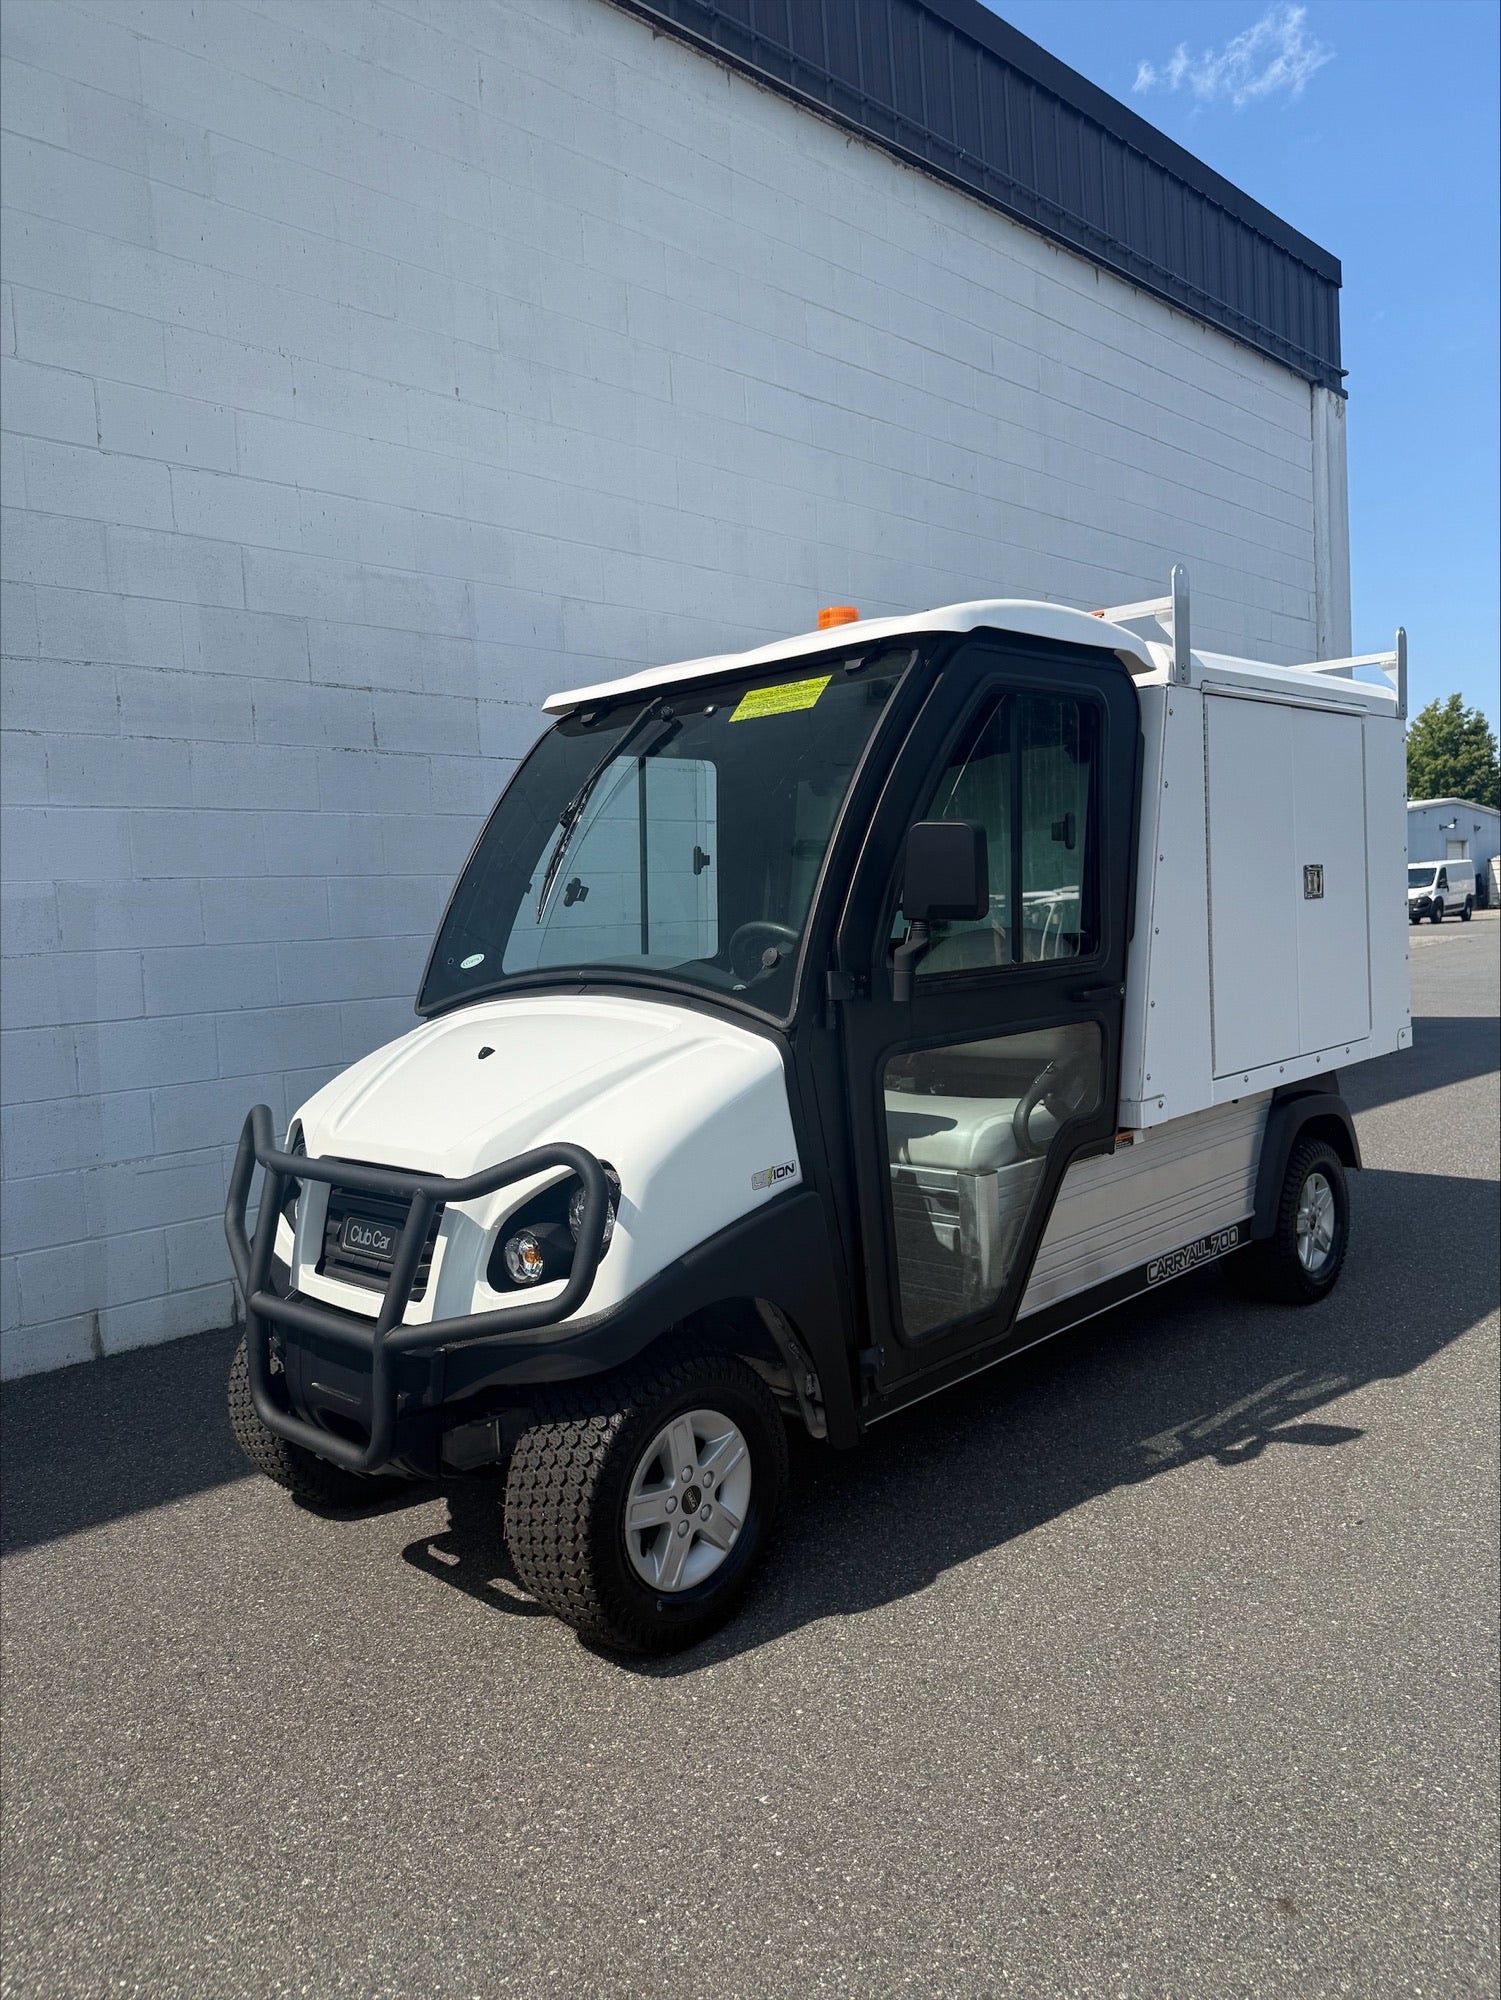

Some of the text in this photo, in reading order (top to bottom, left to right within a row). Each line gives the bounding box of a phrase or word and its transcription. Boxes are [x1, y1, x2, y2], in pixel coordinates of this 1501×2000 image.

[773, 1162, 795, 1180] ION
[350, 1225, 391, 1249] Club Car
[1147, 1226, 1239, 1284] CARRYALL 700
